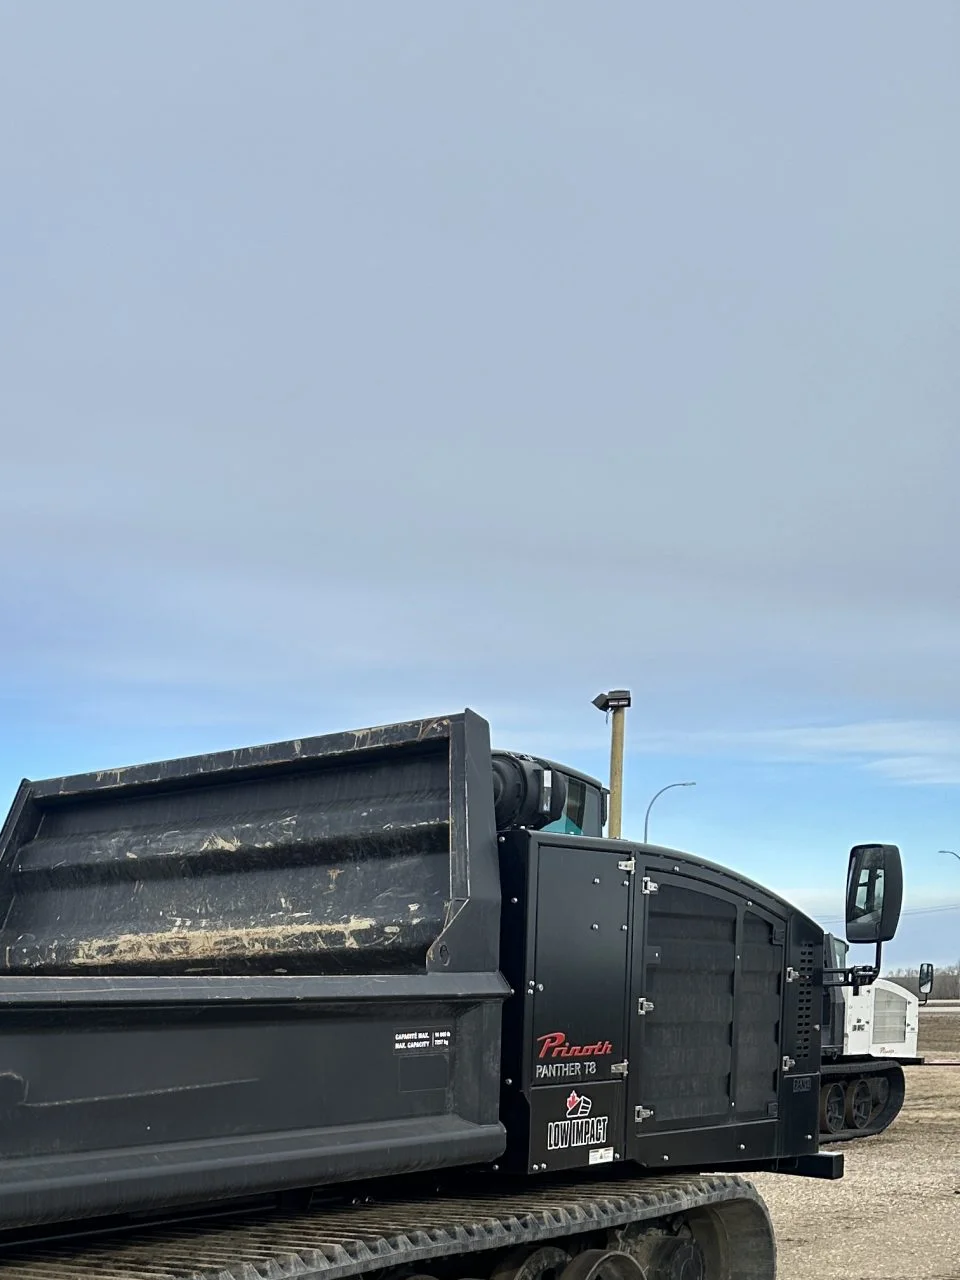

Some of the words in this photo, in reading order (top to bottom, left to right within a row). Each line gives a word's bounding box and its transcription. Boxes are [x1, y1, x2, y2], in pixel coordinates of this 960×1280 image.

[537, 1032, 613, 1058] Prinoth
[536, 1062, 581, 1078] PANTHER
[584, 1061, 597, 1075] T8
[547, 1120, 571, 1150] LOW
[571, 1116, 609, 1147] IMPACT
